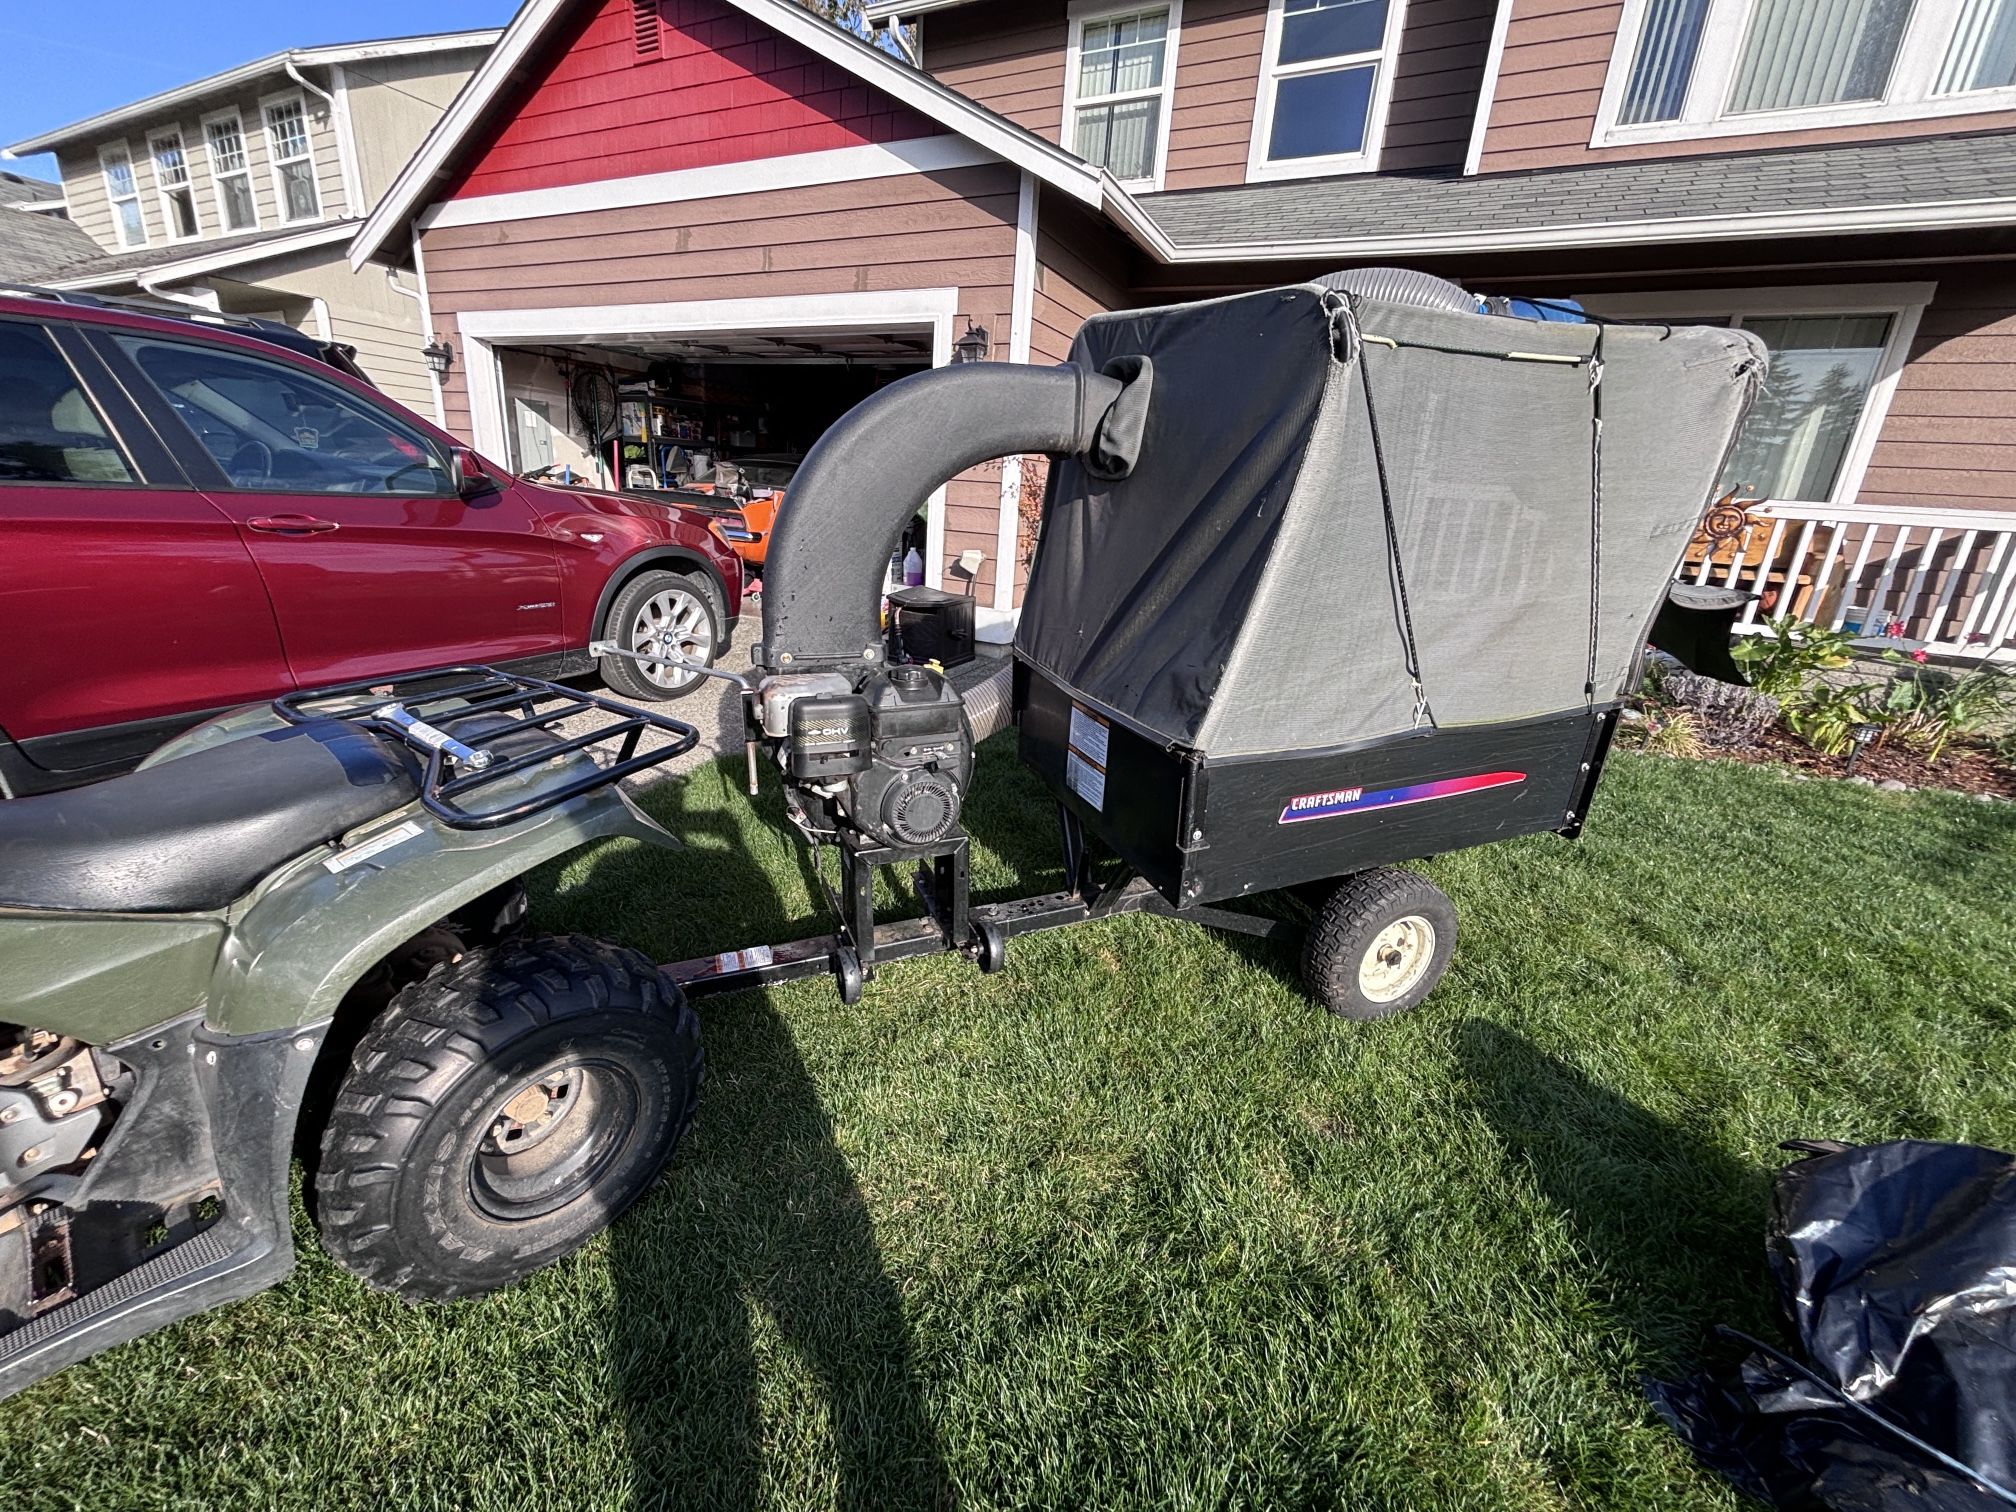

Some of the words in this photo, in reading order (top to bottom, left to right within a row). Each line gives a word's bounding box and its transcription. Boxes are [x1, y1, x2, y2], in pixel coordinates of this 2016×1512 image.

[822, 727, 849, 736] OHV
[1291, 788, 1362, 811] CRAFTSMAN
[423, 1131, 496, 1262] MAXXIS
